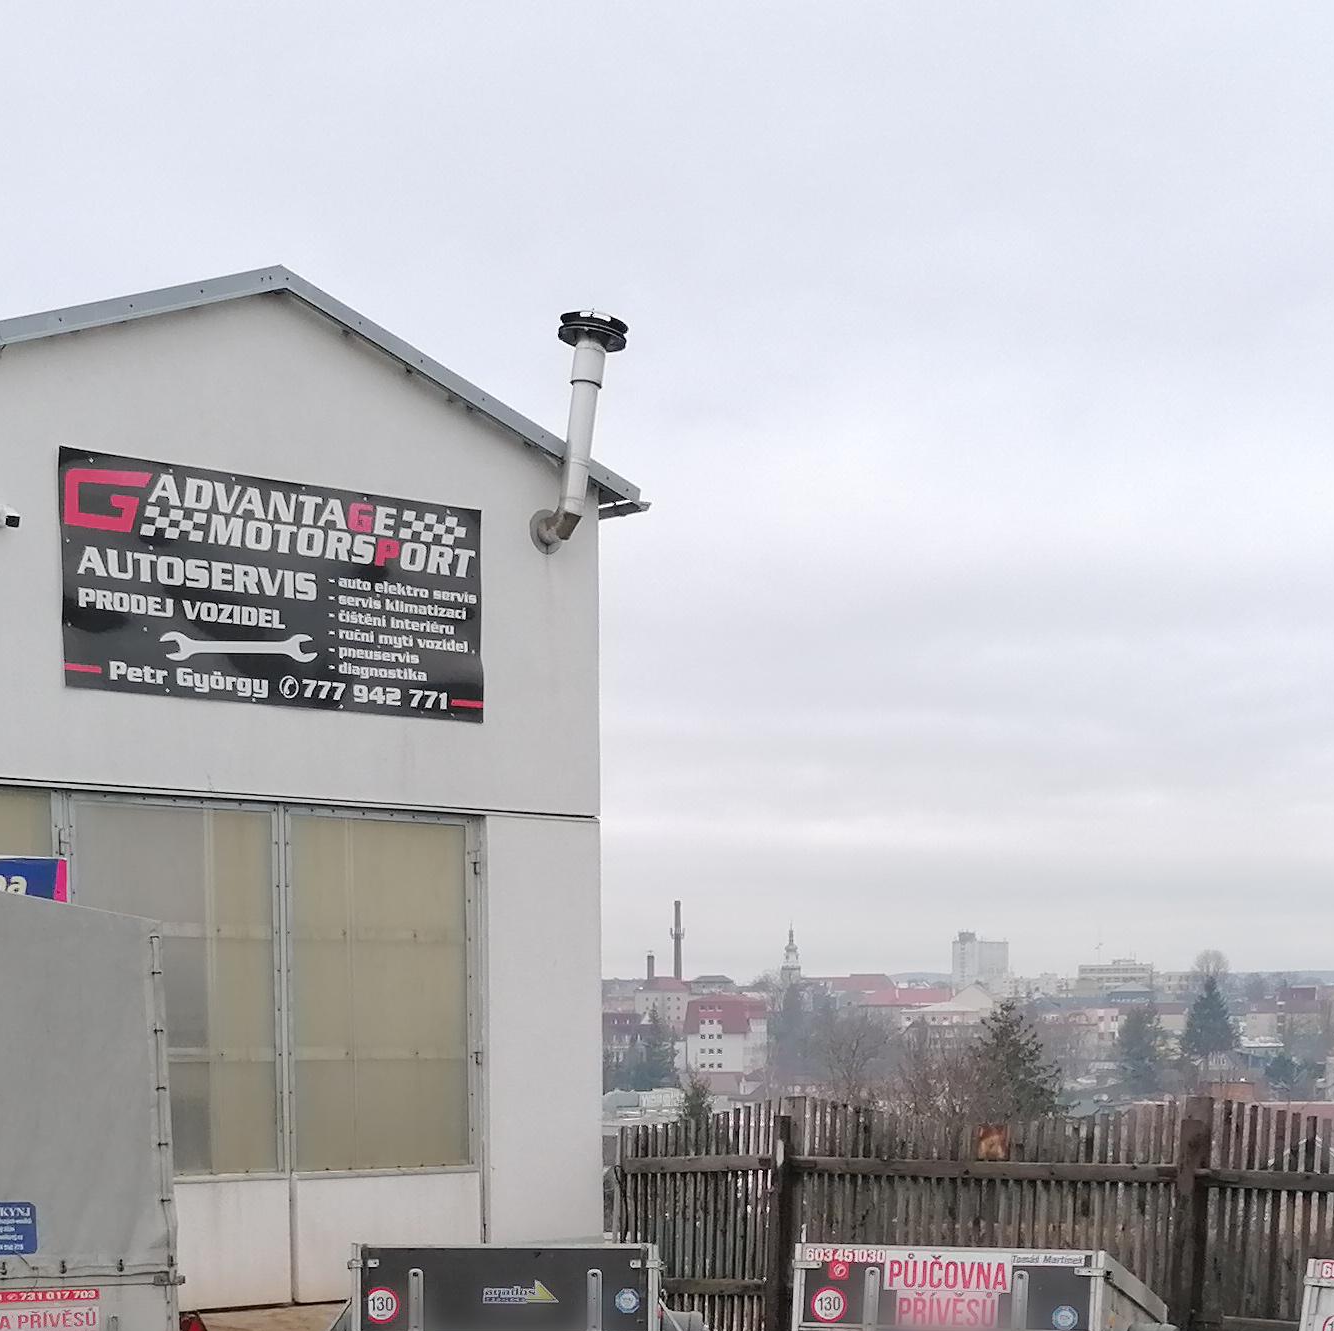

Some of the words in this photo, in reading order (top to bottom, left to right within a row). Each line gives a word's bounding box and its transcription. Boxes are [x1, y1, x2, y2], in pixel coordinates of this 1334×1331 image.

[148, 474, 398, 537] ADVANTAGE
[207, 516, 476, 578] MOTORSPORT
[77, 546, 317, 601] AUTOSERVIS
[338, 577, 371, 591] auto
[375, 581, 429, 598] elektro
[433, 589, 477, 605] servis
[338, 594, 382, 610] servis
[78, 587, 175, 618] PRODEJ
[182, 600, 286, 630] VOZIDEL
[338, 646, 420, 664] pneuservis
[417, 638, 468, 653] vozidel
[338, 661, 429, 682] diagnostika
[109, 661, 168, 685] Petr
[176, 668, 269, 699] György
[301, 679, 346, 701] 777
[353, 684, 402, 706] 942
[409, 689, 448, 710] 771
[807, 1248, 885, 1263] 603451030
[888, 1253, 1007, 1290] PŮJČOVNA
[369, 1296, 394, 1311] 130
[818, 1297, 841, 1311] 130
[898, 1291, 996, 1328] PŘÍVĚSŮ
[17, 1308, 97, 1330] PŘÍVĚSŮ
